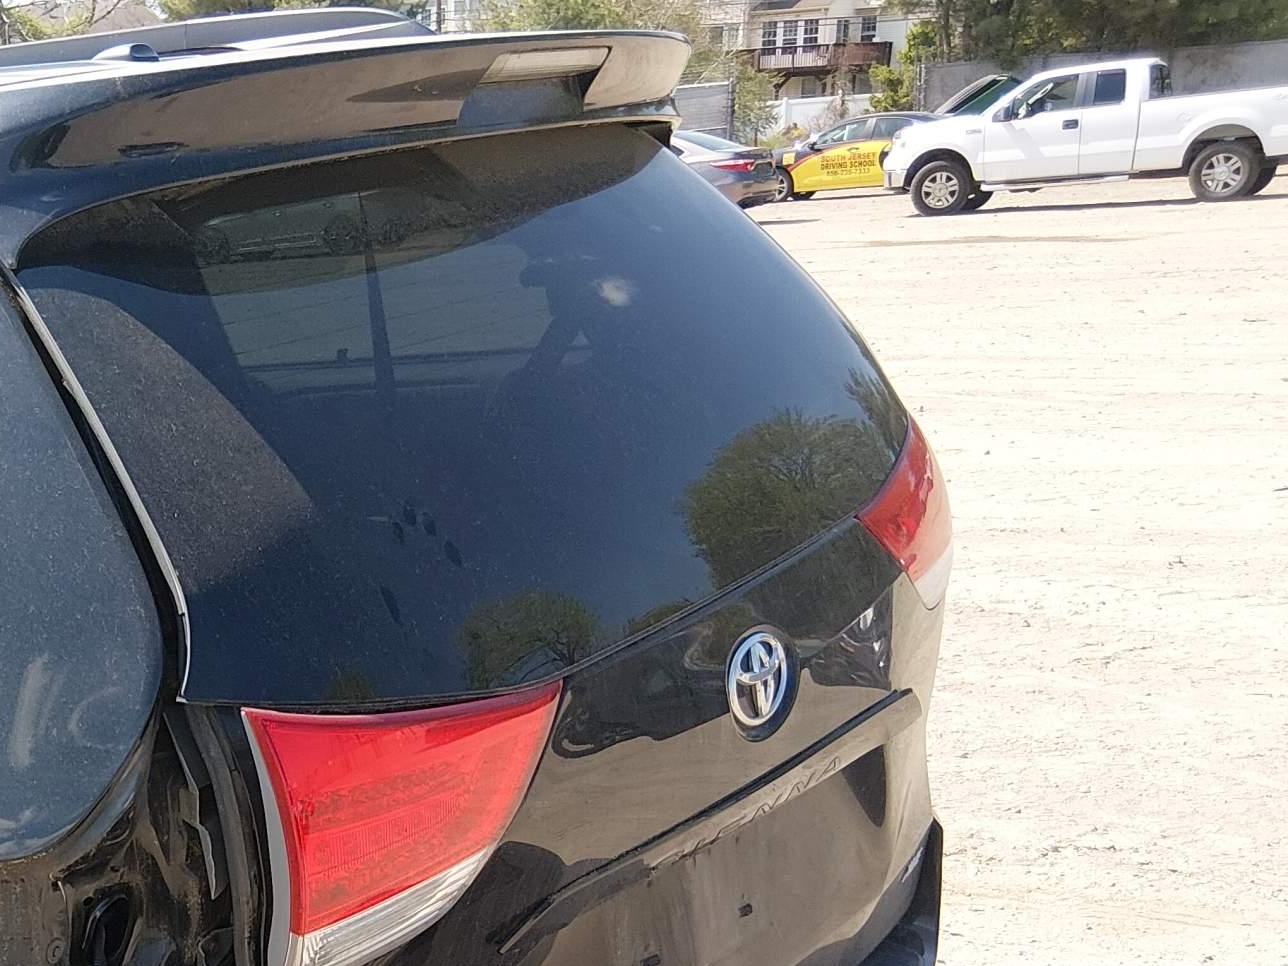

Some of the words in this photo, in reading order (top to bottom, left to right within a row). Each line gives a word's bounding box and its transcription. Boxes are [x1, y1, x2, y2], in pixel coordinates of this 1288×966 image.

[820, 154, 846, 162] SOUTH
[848, 152, 877, 160] JERSEY
[820, 161, 847, 170] DRIVING
[850, 160, 876, 168] SCHOOL
